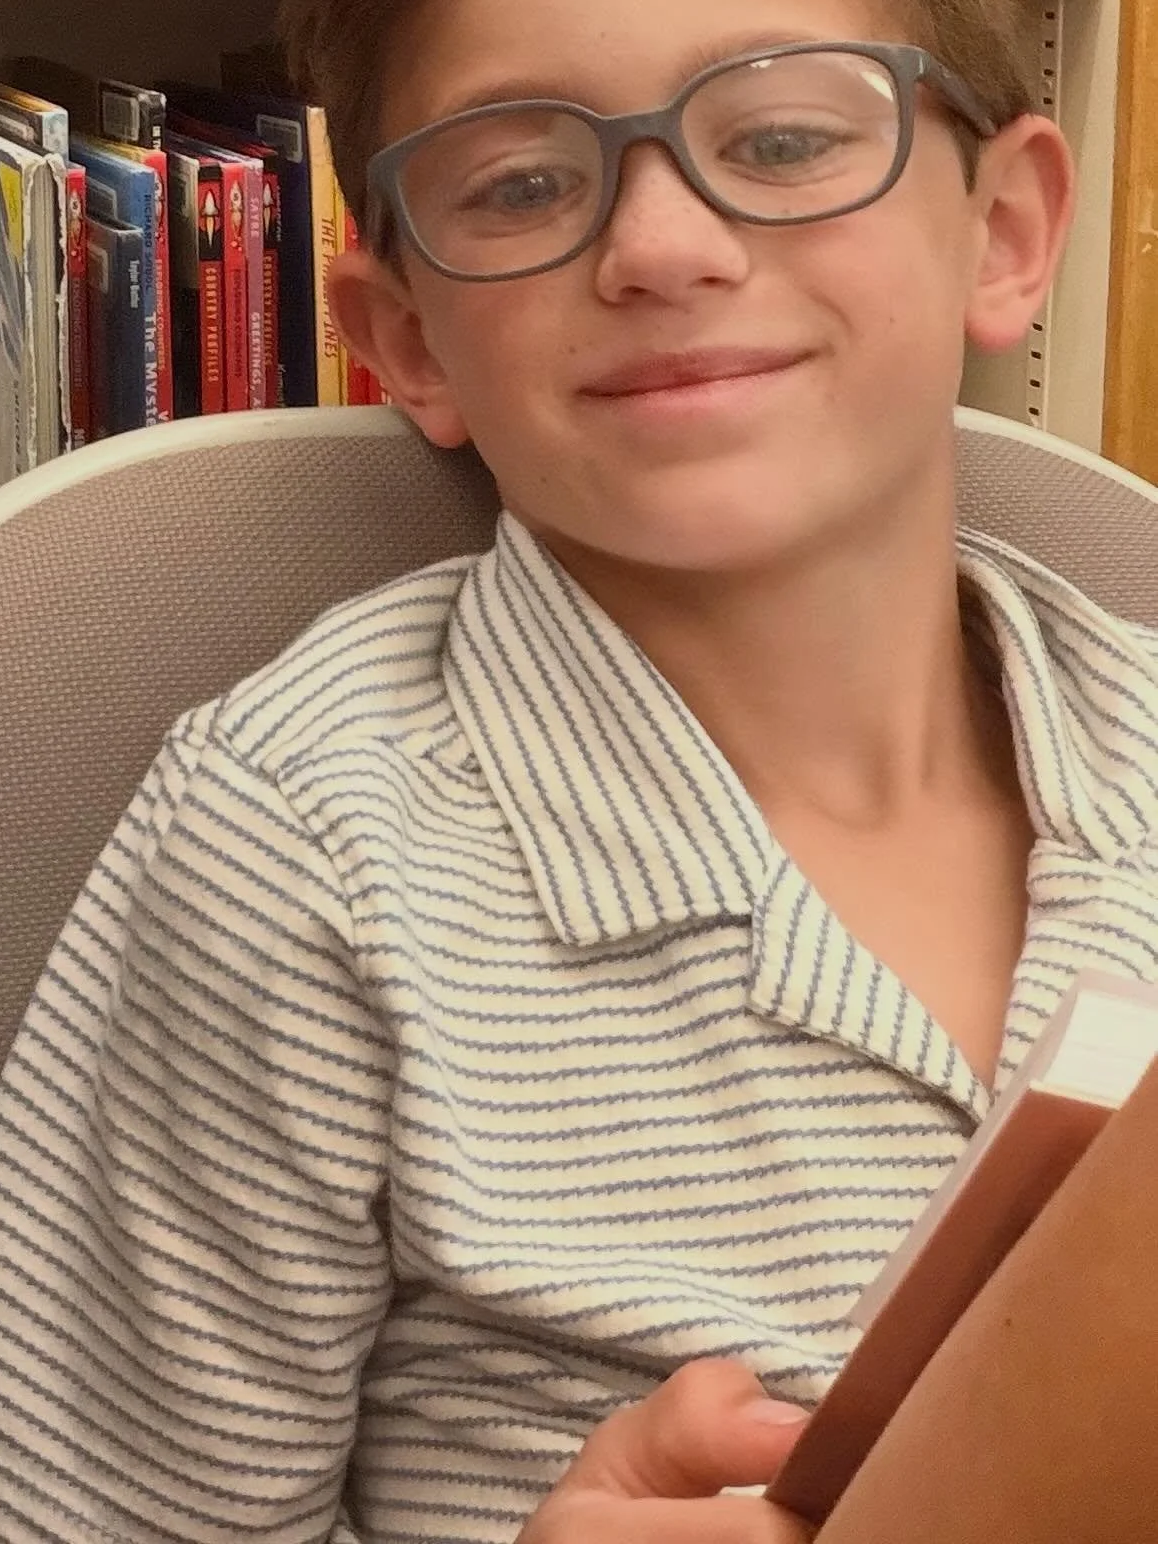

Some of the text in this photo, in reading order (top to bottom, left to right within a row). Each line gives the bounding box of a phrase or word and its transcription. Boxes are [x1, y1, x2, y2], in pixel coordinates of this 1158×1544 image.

[141, 194, 154, 247] RICHARD
[247, 196, 261, 238] SAYRE
[320, 216, 334, 247] THE
[142, 312, 158, 352] The
[203, 267, 221, 382] COUNTRY PROFILES
